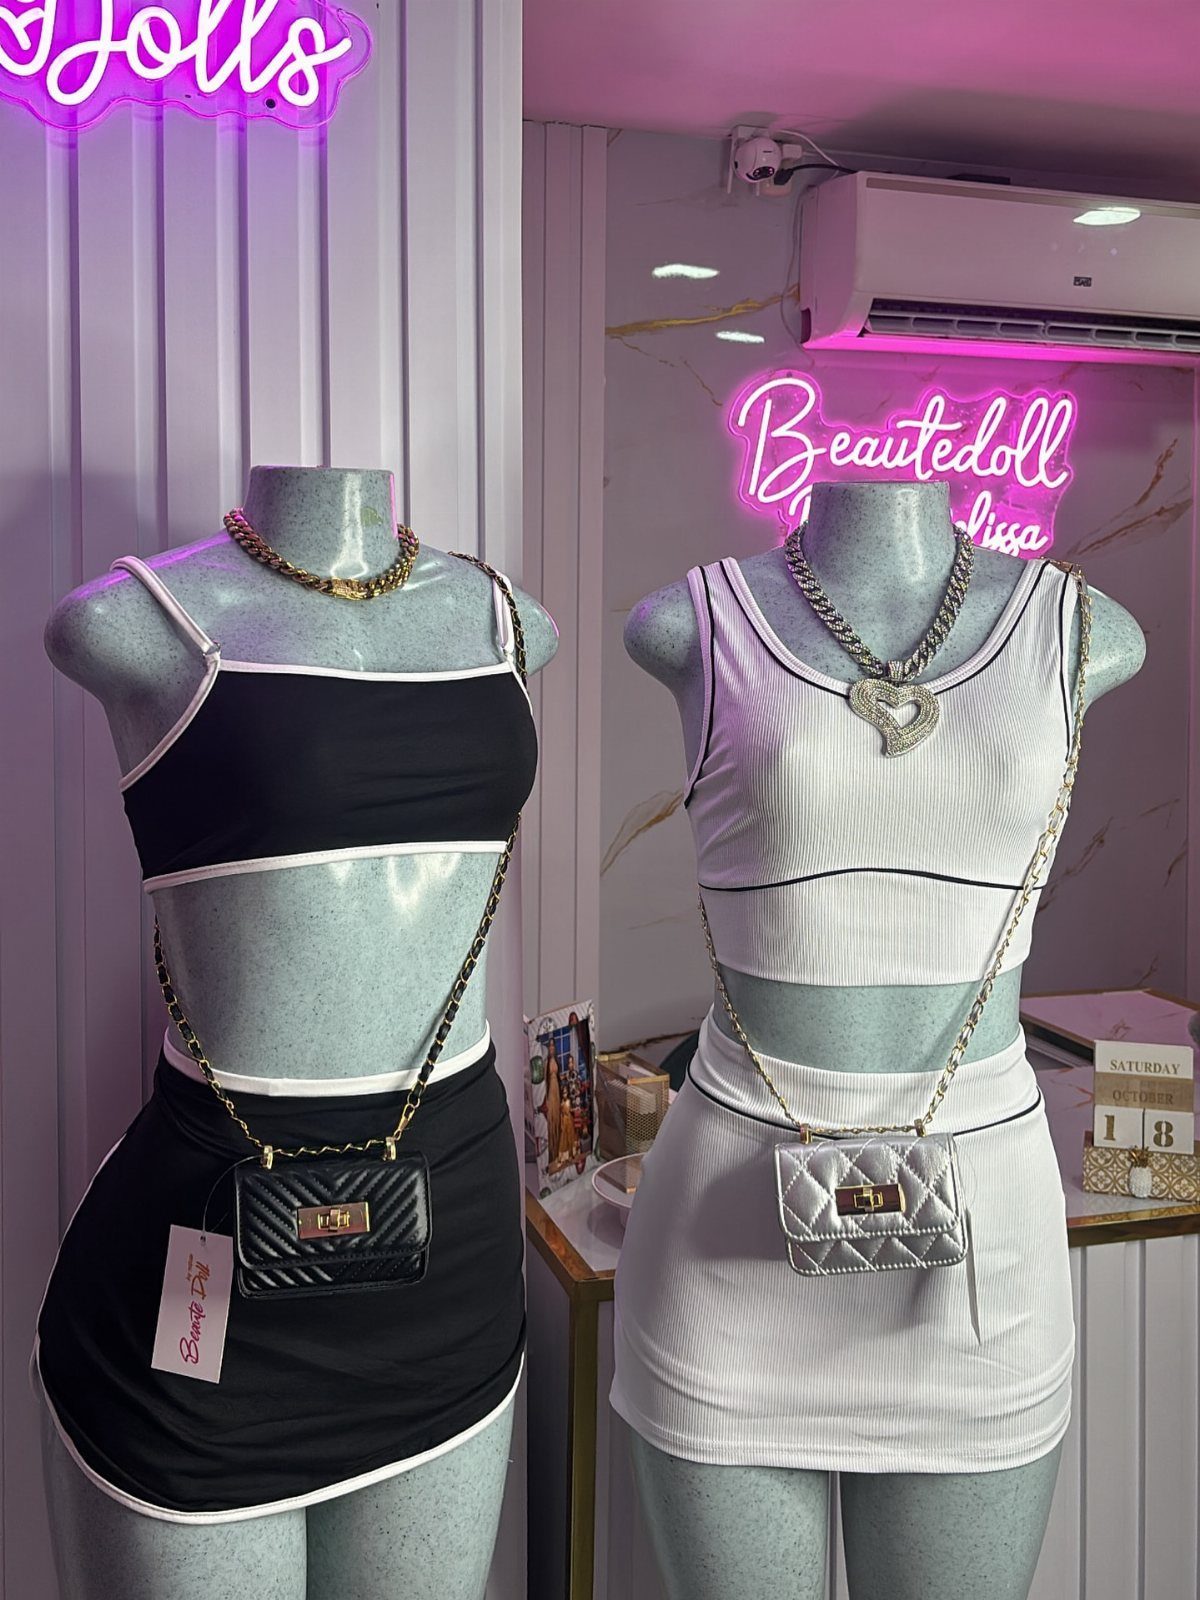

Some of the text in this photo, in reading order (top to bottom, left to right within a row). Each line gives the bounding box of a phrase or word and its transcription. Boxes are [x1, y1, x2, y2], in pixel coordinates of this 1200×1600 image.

[737, 377, 1073, 503] Beautedoll
[1110, 1059, 1181, 1075] SATURDAY
[1112, 1089, 1174, 1105] OCTOBER
[191, 1261, 212, 1300] Doll
